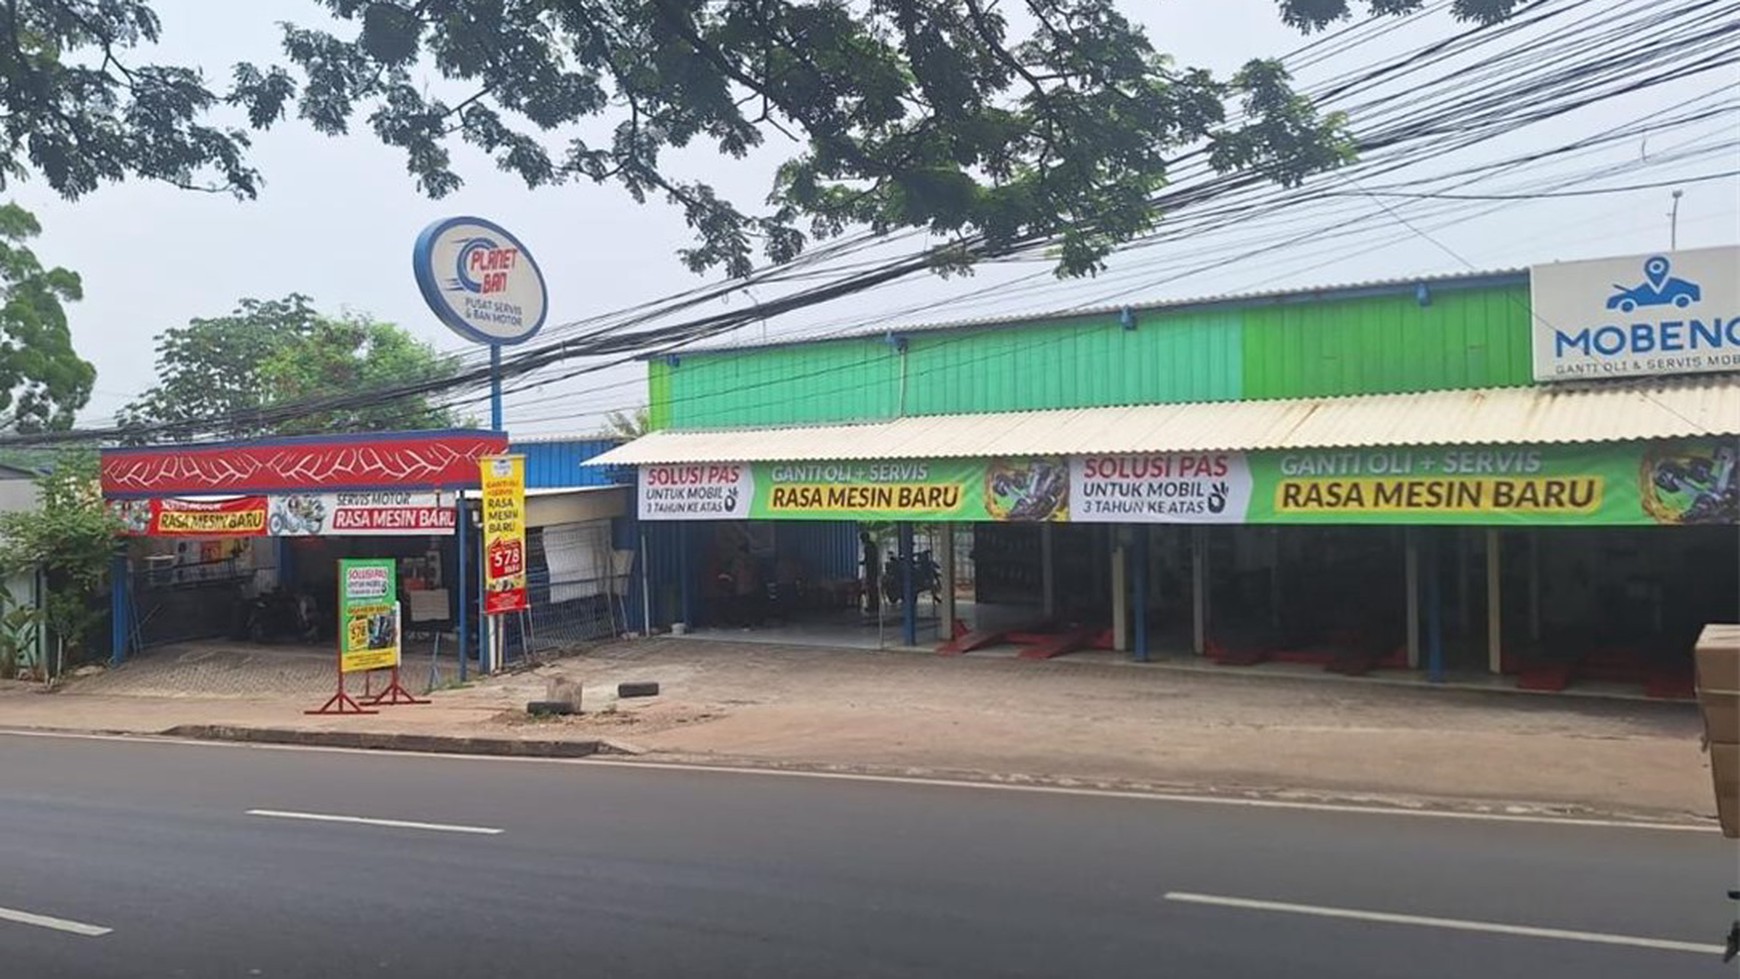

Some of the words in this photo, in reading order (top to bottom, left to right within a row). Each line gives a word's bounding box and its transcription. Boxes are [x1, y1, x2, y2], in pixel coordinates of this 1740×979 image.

[471, 248, 518, 271] PLANET
[483, 272, 507, 294] BAN
[465, 297, 492, 310] PUSAT
[494, 301, 522, 316] SERVIS
[474, 309, 491, 321] BAN
[493, 313, 523, 327] MOTOR
[1556, 364, 1597, 375] GANTI
[1603, 362, 1628, 373] OLI
[1634, 360, 1641, 370] &
[1647, 355, 1702, 369] SERVIS
[772, 464, 820, 482] GANTI
[825, 463, 853, 481] OLI
[855, 468, 866, 479] +
[869, 463, 928, 482] SERVIS
[1084, 457, 1172, 479] SOLUSI
[1179, 454, 1229, 478] PAS
[1280, 453, 1360, 477] GANTI
[1367, 453, 1413, 475] OLI
[1419, 459, 1433, 473] +
[1442, 450, 1542, 474] SERVIS
[649, 466, 703, 485] SOLUSI
[708, 465, 740, 484] PAS
[646, 488, 683, 500] UNTUK
[687, 487, 722, 499] MOBIL
[773, 487, 823, 508] RASA
[827, 487, 892, 508] MESIN
[898, 486, 960, 508] BARU
[1083, 481, 1142, 498] UNTUK
[1147, 480, 1205, 498] MOBIL
[1282, 482, 1366, 508] RASA
[1373, 481, 1483, 508] MESIN
[1492, 479, 1596, 508] BARU
[337, 492, 370, 506] SERVIS
[372, 492, 411, 505] MOTOR
[488, 498, 514, 508] RASA
[654, 502, 683, 513] TAHUN
[687, 502, 697, 512] KE
[699, 501, 722, 512] ATAS
[1083, 501, 1091, 513] 3
[1094, 500, 1144, 513] TAHUN
[1147, 500, 1166, 513] KE
[1169, 500, 1205, 513] ATAS
[161, 513, 188, 528] RASA
[229, 512, 262, 528] BARU
[336, 511, 370, 527] RASA
[373, 510, 416, 527] MESIN
[419, 509, 455, 526] BARU
[488, 509, 519, 520] MESIN
[488, 522, 516, 533] BARU
